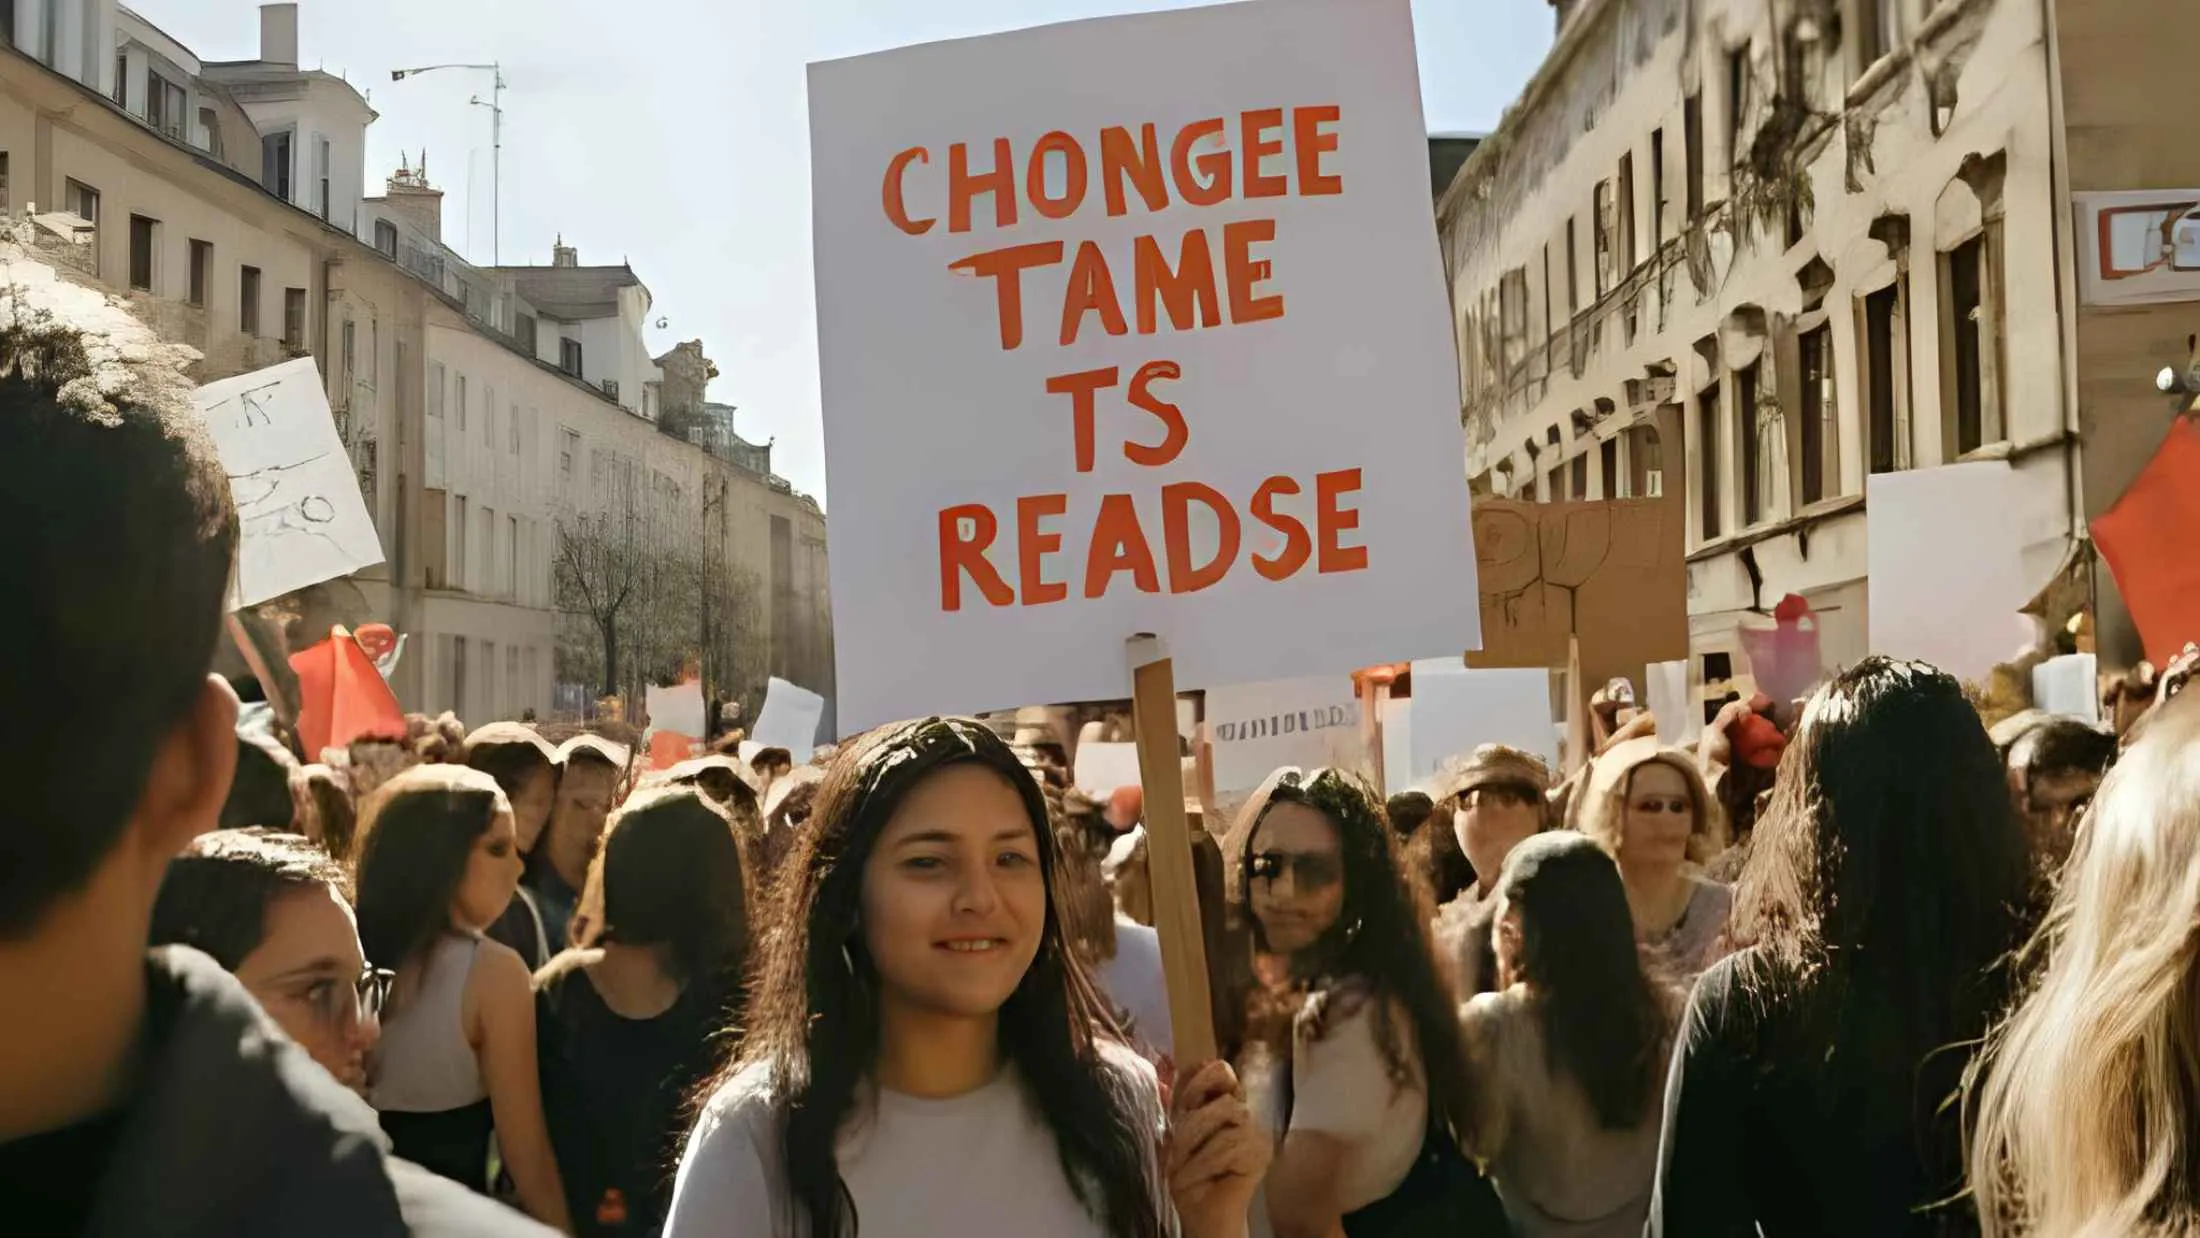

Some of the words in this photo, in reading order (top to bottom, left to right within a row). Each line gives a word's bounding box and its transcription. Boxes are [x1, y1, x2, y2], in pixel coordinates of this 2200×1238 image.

[882, 104, 1343, 236] CHONGEE
[948, 218, 1286, 350] TAME
[1046, 359, 1190, 473] TS
[938, 467, 1370, 612] READSE
